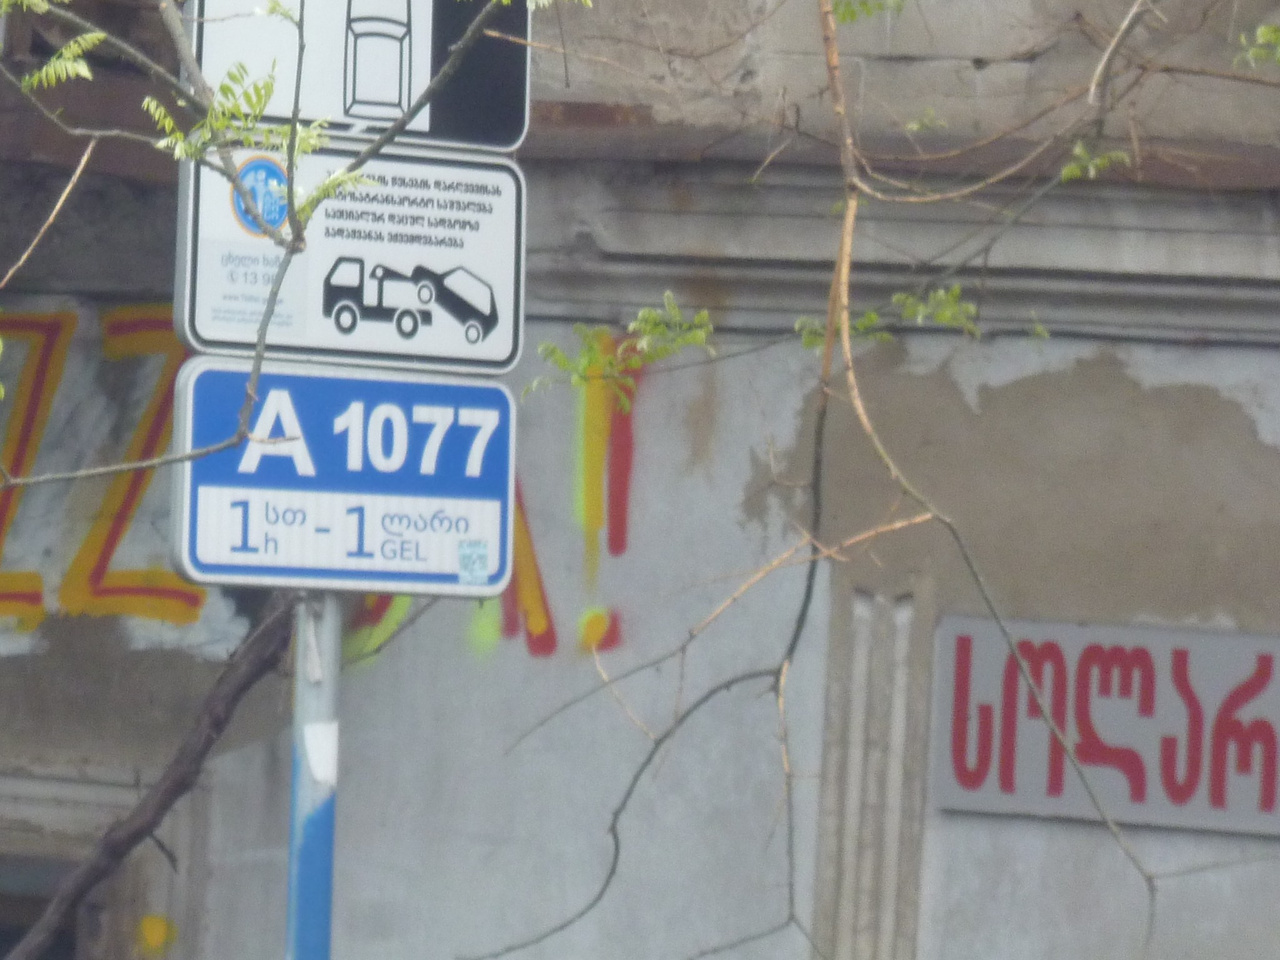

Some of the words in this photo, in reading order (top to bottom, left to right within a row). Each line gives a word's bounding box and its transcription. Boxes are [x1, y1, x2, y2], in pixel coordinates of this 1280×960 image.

[238, 389, 317, 477] A
[333, 401, 500, 479] 1077
[229, 499, 259, 555] 1
[265, 501, 307, 526] სთ
[345, 506, 375, 559] 1
[381, 510, 470, 538] ლარი
[380, 539, 428, 563] GEL
